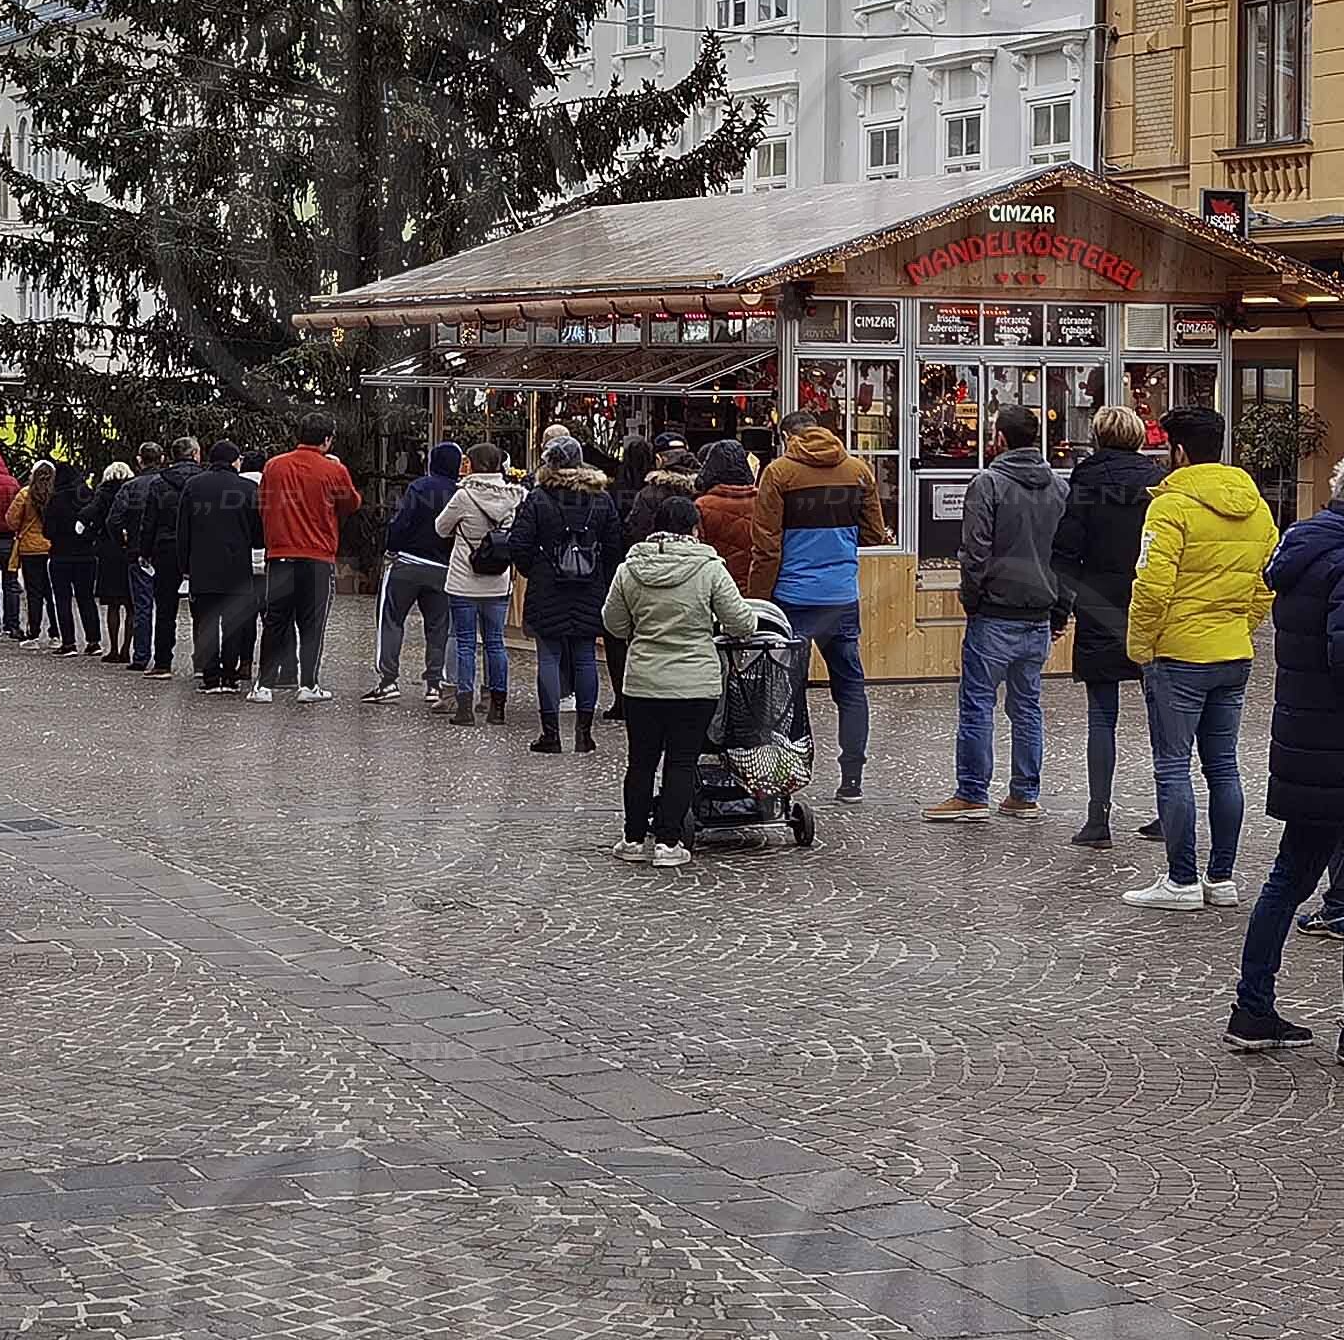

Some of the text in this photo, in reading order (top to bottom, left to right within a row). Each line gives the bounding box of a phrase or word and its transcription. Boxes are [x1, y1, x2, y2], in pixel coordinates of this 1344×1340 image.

[989, 203, 1056, 224] CIMZAR
[904, 227, 1144, 292] MANDELRÖSTEREI
[854, 316, 896, 328] CIMZAR
[1176, 322, 1216, 334] CIMZAR
